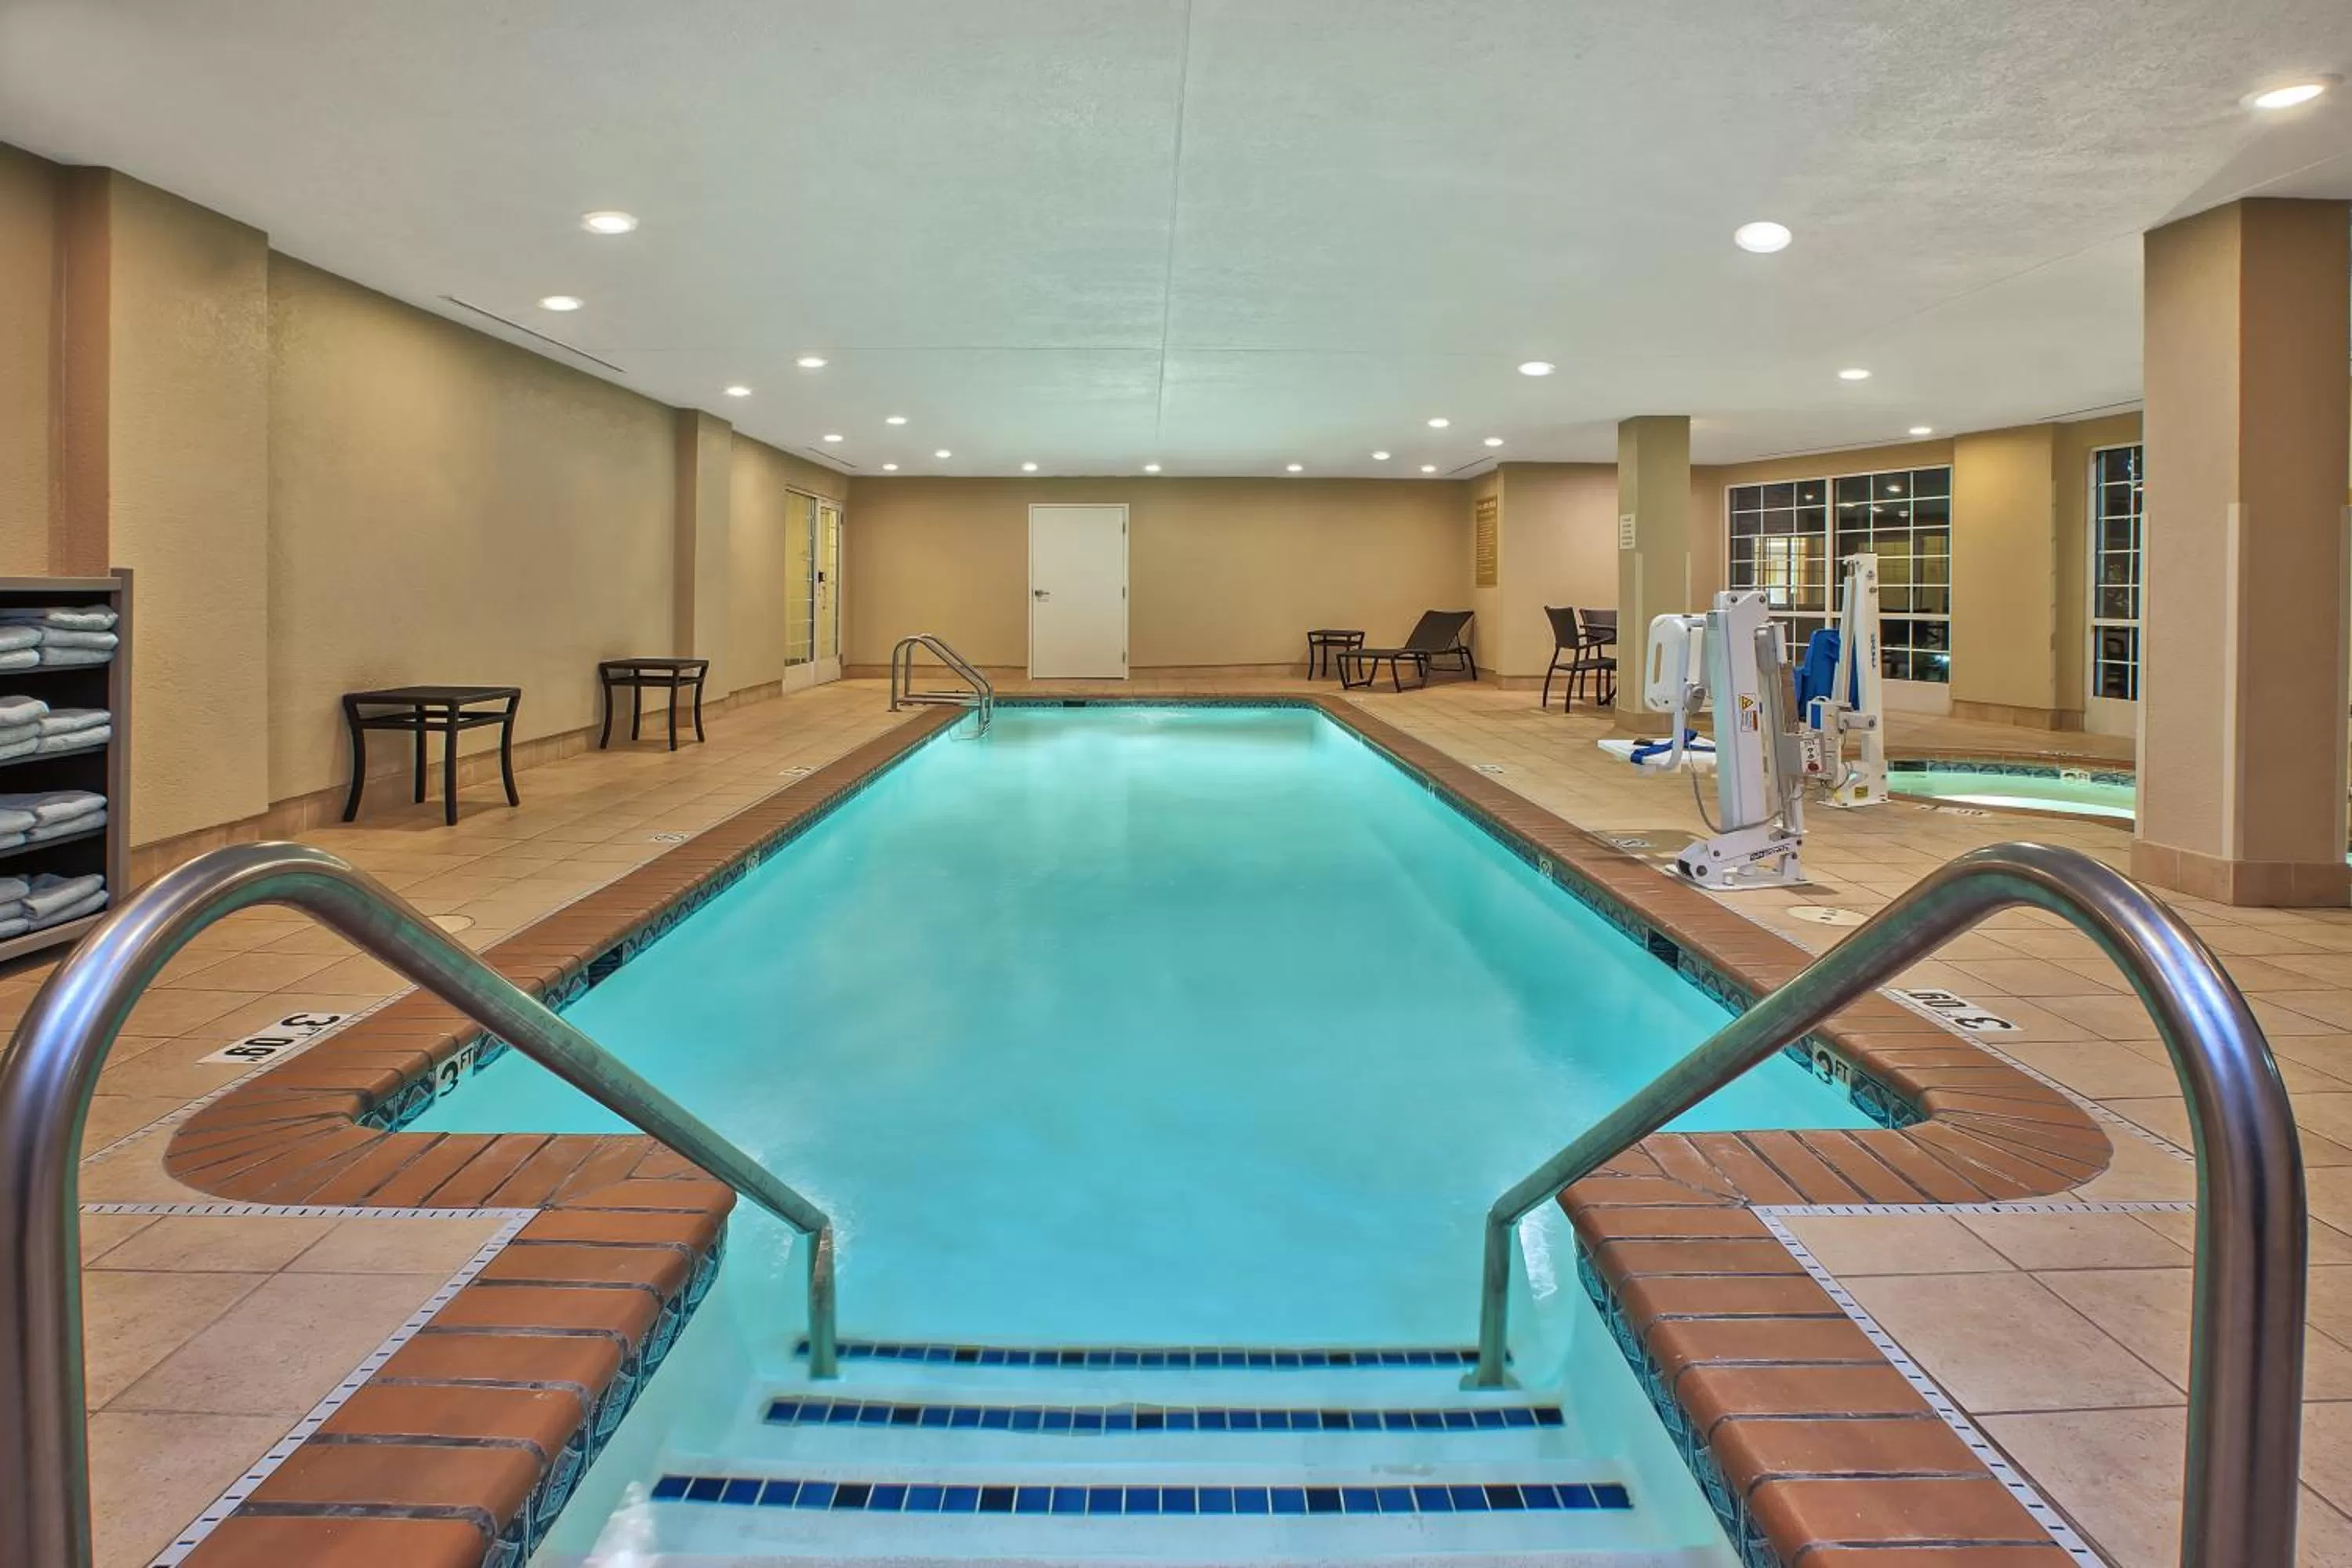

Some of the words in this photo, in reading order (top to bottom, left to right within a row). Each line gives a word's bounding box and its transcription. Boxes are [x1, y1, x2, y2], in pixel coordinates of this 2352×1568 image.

[280, 1014, 341, 1028] 3
[1955, 1017, 2013, 1029] 3
[439, 1061, 459, 1098] 3
[460, 1047, 473, 1069] FT
[1817, 1051, 1834, 1086] 3
[1836, 1060, 1849, 1082] FT
